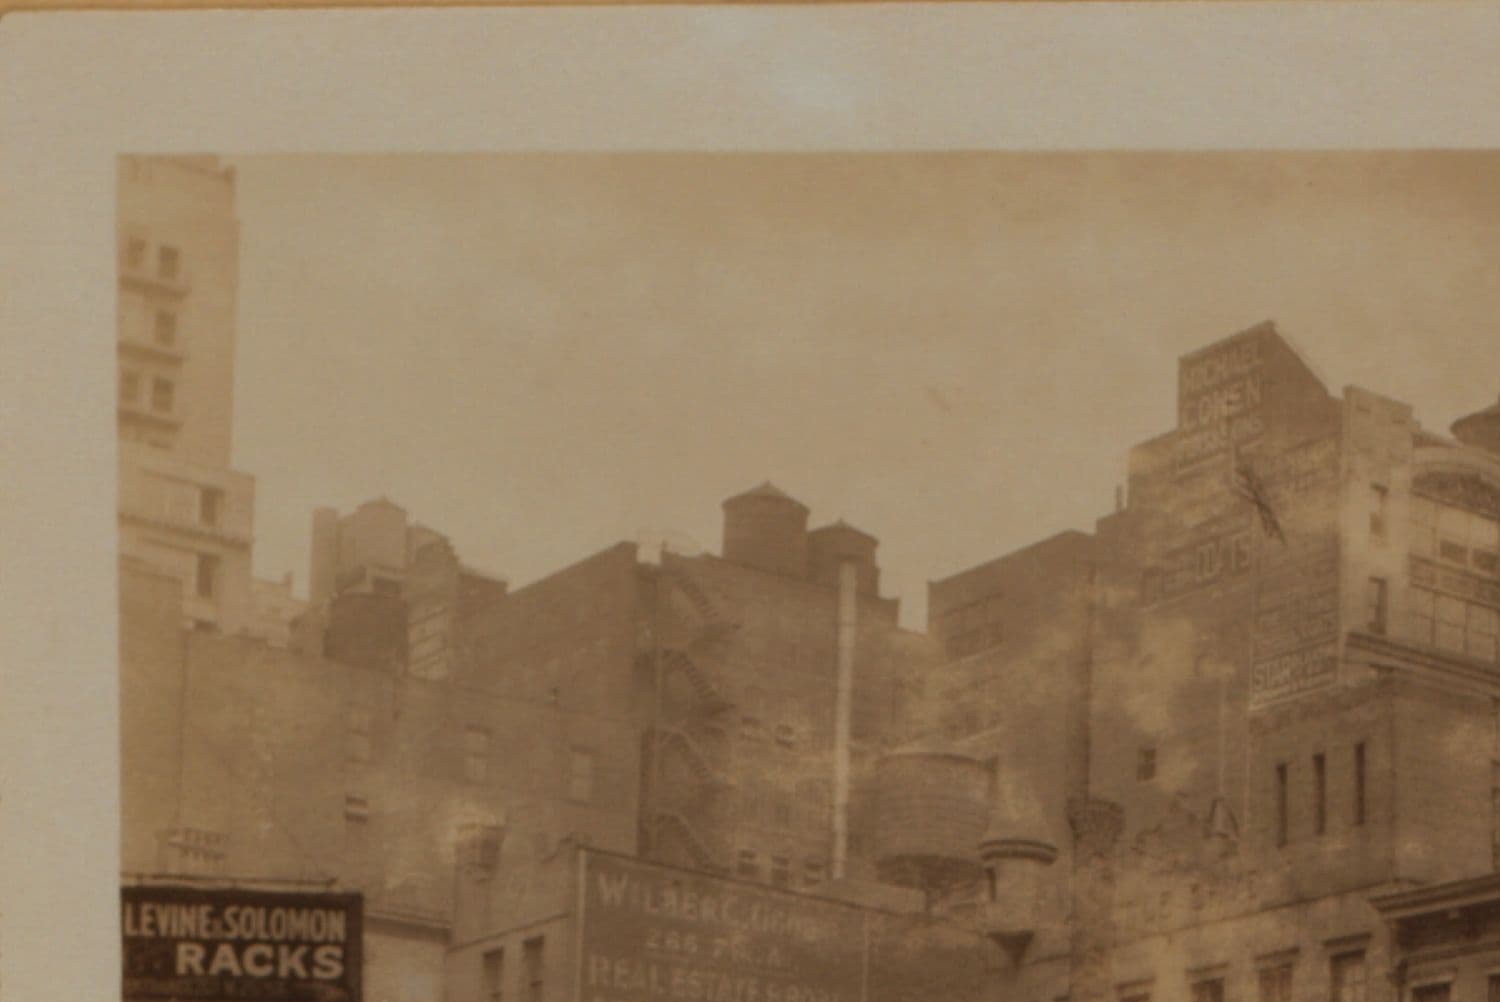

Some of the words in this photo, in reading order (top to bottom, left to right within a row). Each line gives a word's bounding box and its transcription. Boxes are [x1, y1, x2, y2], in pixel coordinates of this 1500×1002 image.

[125, 902, 214, 939] LEVINE
[223, 906, 347, 944] SOLOMON
[176, 943, 345, 980] RACKS
[588, 953, 664, 995] REAL
